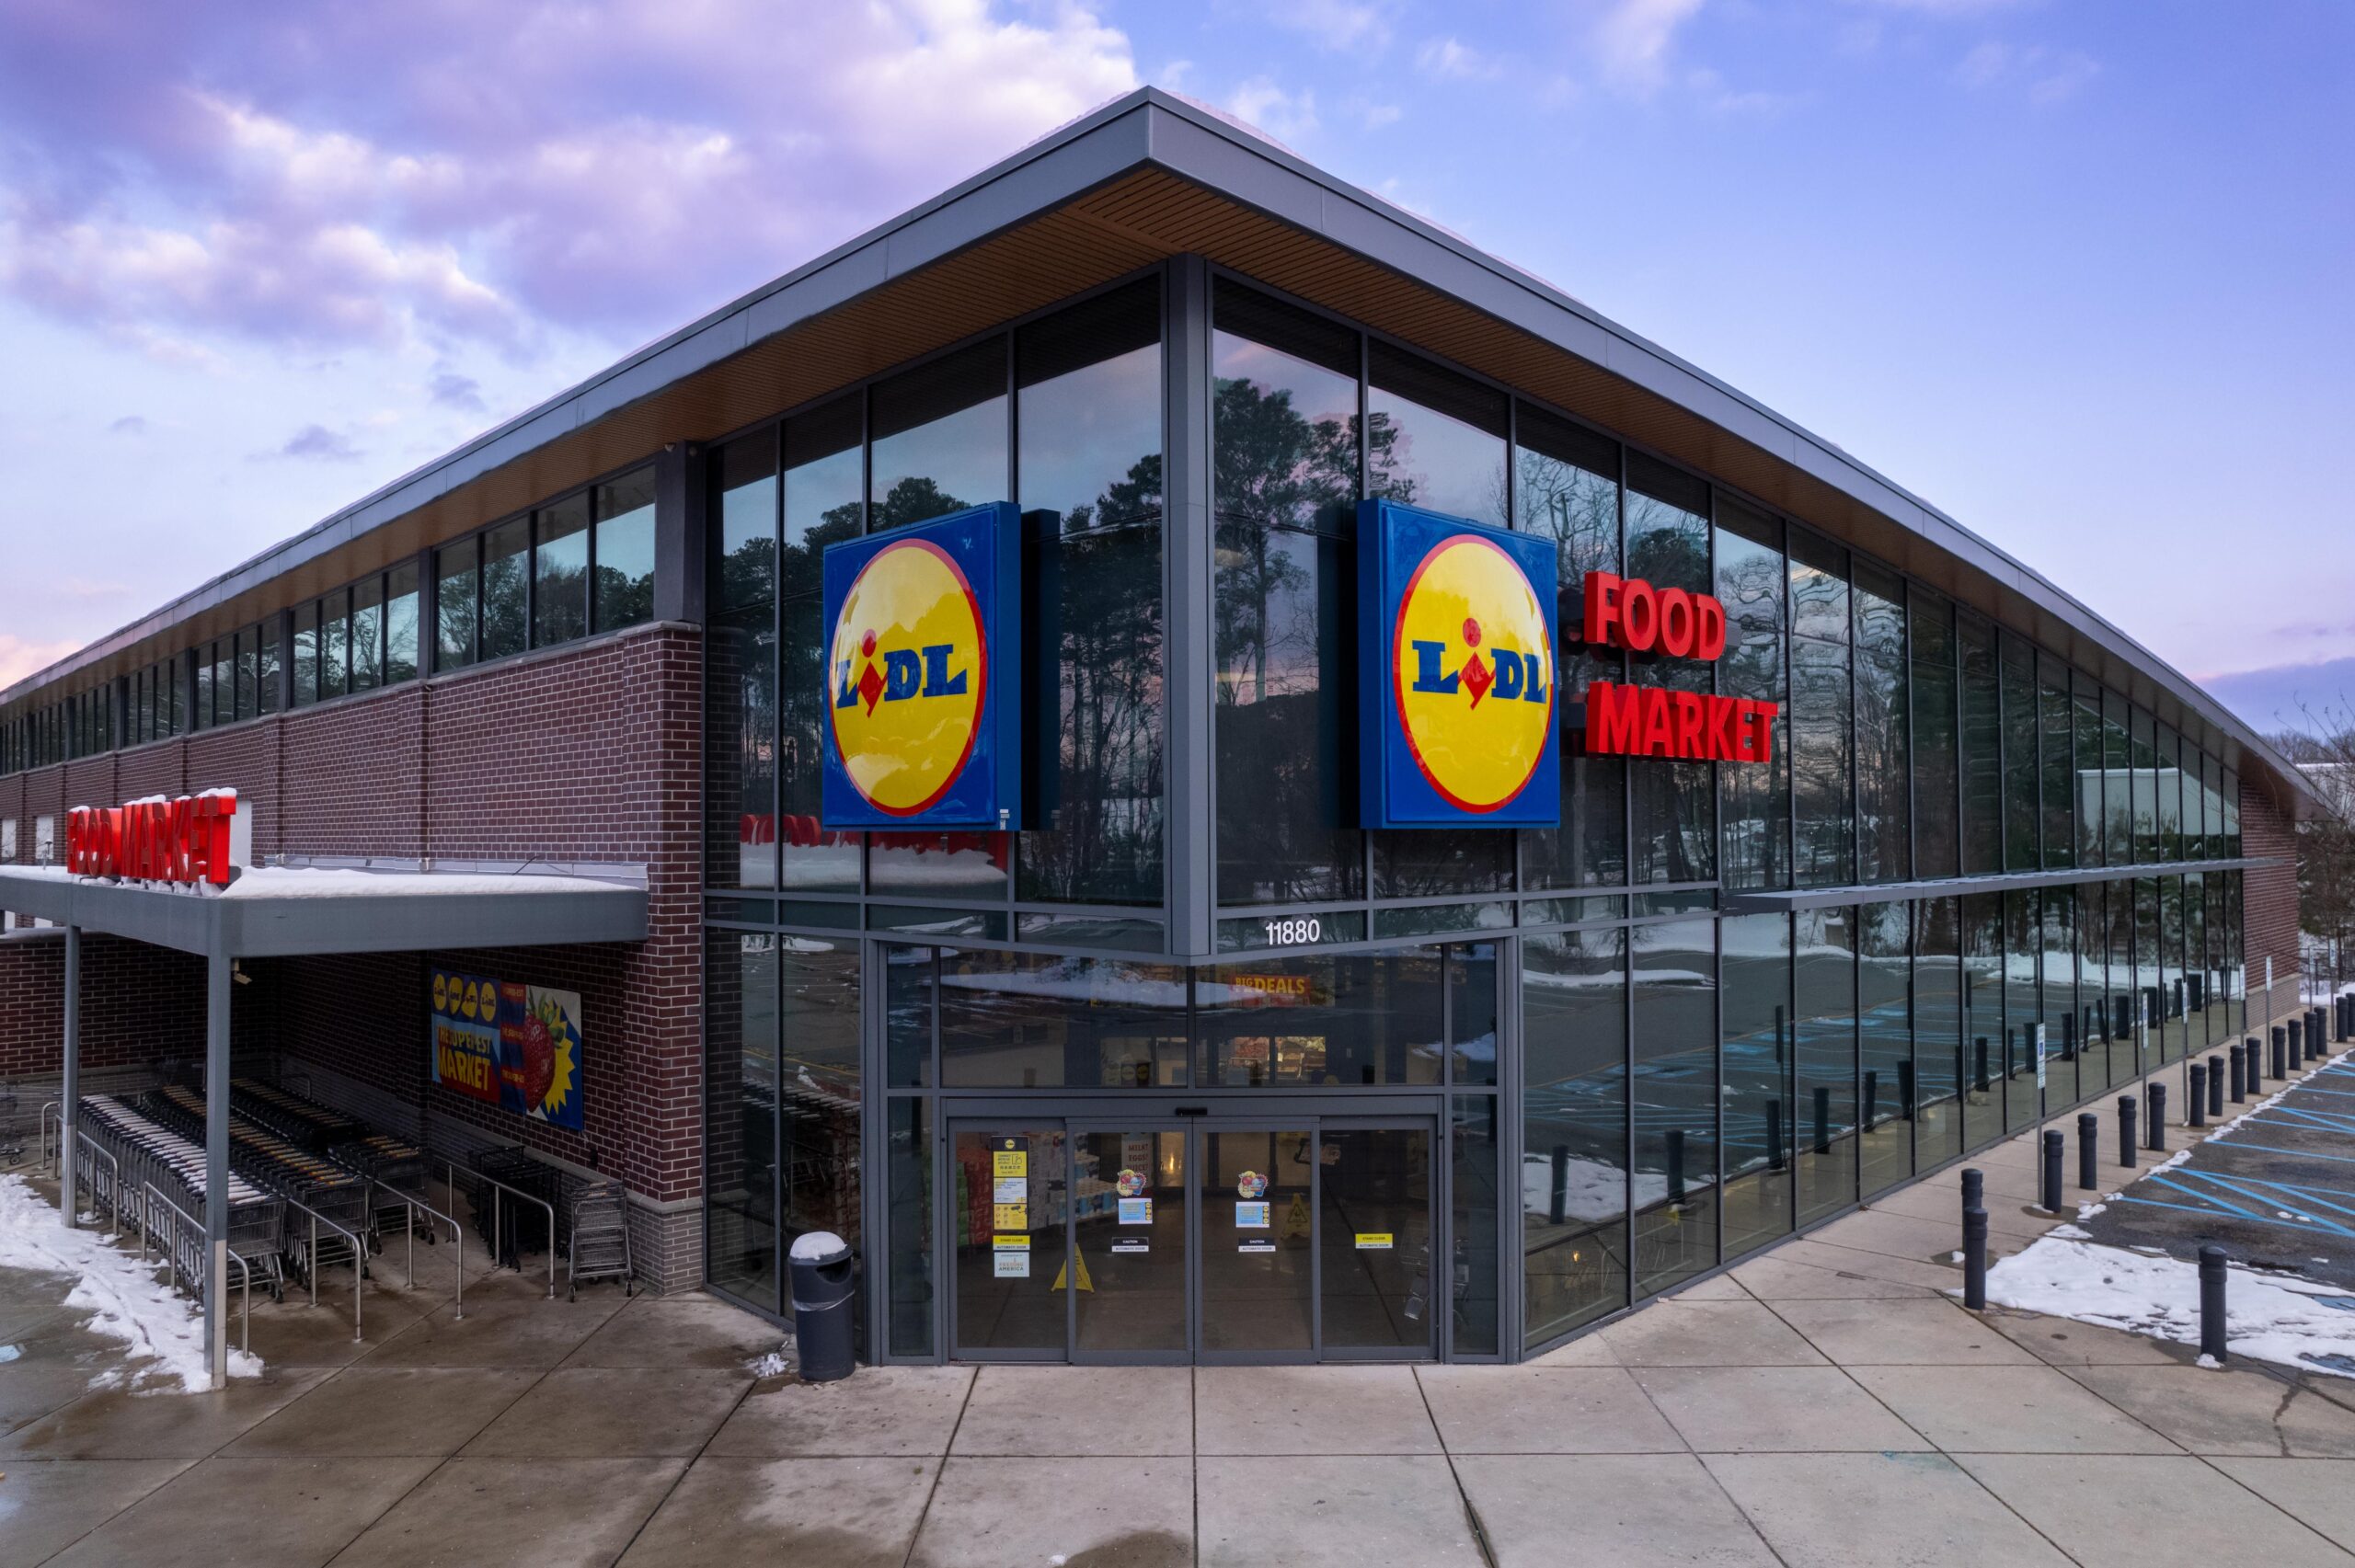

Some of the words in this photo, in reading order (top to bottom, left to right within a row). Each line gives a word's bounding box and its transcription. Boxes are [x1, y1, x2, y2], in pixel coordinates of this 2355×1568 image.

[1584, 570, 1726, 661] FOOD
[1585, 681, 1778, 763] MARKET
[67, 807, 121, 876] FOOD
[121, 794, 236, 884] MARKET
[1265, 919, 1320, 945] 11880
[1254, 978, 1305, 994] DEALS
[439, 1047, 490, 1091] MARKET
